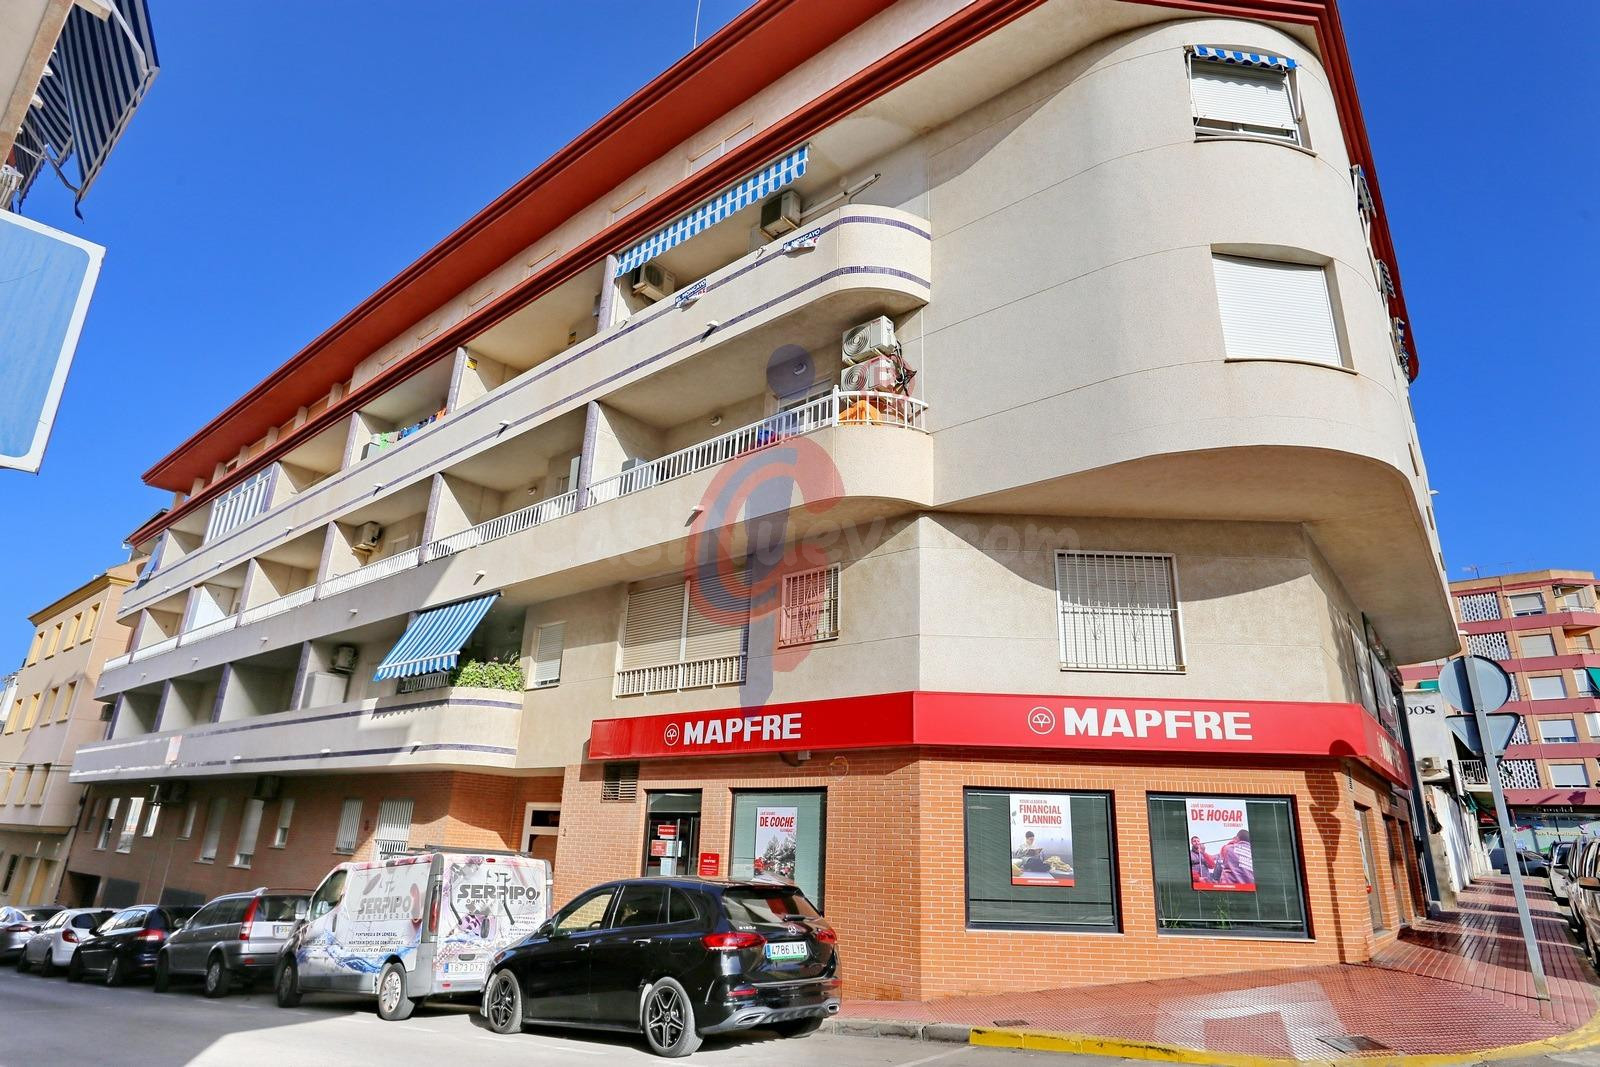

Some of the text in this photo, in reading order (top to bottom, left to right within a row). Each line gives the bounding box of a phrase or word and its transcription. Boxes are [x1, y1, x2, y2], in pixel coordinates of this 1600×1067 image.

[683, 712, 802, 746] MAPFRE
[1063, 707, 1253, 741] MAPFRE
[1019, 804, 1062, 815] FINANCIAL
[1191, 809, 1243, 822] DE HOGAR
[759, 816, 795, 827] DE COCHE
[1023, 815, 1062, 825] PLANNING
[457, 884, 537, 901] SERPIPO
[357, 896, 412, 915] SERPIPO
[772, 943, 805, 955] 4786 LYB
